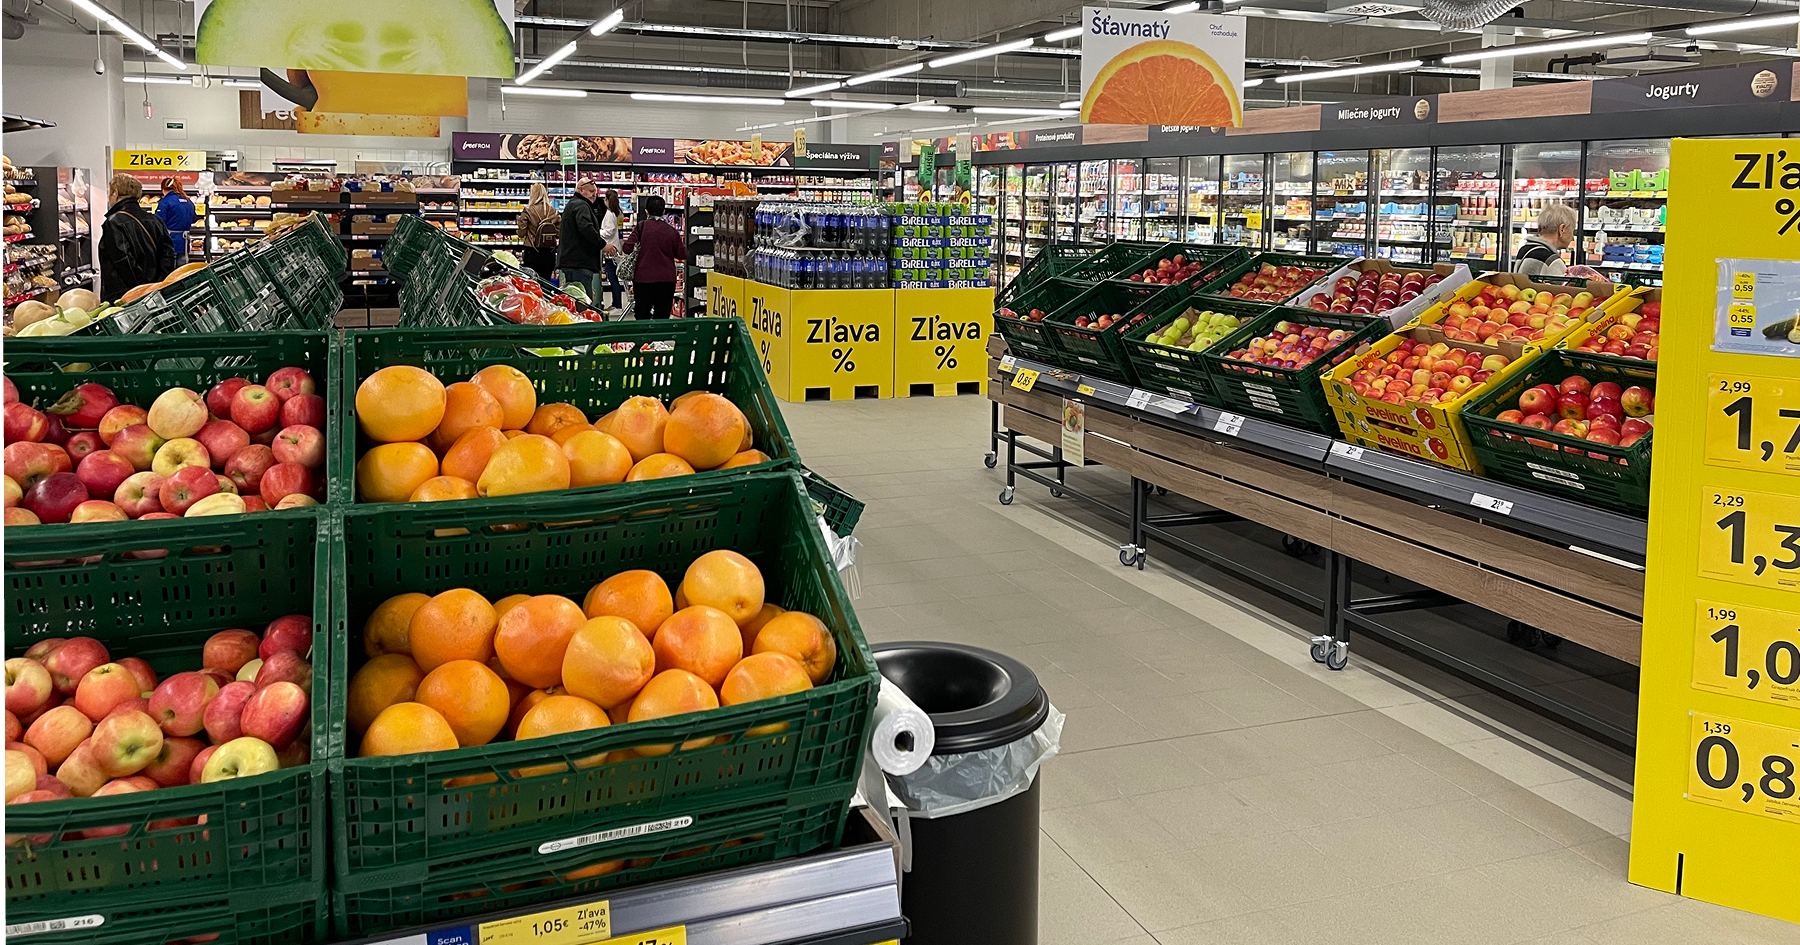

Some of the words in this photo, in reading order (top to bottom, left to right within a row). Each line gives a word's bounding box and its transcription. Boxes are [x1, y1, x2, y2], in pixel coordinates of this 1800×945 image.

[1091, 10, 1170, 39] Šťavnatý
[1645, 82, 1699, 100] Jogurty
[1338, 108, 1369, 120] Mliečne
[1369, 106, 1401, 120] jogurty
[1056, 132, 1075, 142] produkty
[130, 153, 172, 166] Zľava
[177, 155, 191, 166] %
[806, 149, 839, 160] Špeciálna
[839, 152, 861, 161] výživa
[1334, 178, 1355, 190] MIX
[712, 286, 737, 318] Zľava
[752, 297, 782, 338] Zľava
[806, 316, 880, 344] Zľava
[911, 314, 981, 341] Zľava
[761, 340, 772, 374] %
[831, 347, 856, 373] %
[934, 345, 958, 370] %
[1356, 350, 1381, 368] evelina
[1016, 372, 1033, 387] 0,85
[1719, 380, 1751, 394] 2,99
[1366, 405, 1410, 426] evelina
[1377, 433, 1421, 455] evelina
[1713, 494, 1744, 507] 2,29
[1707, 607, 1737, 621] 1,99
[1703, 721, 1731, 735] 1,39
[577, 907, 606, 921] Zľava
[74, 917, 94, 926] 216
[578, 918, 607, 932] -47%
[437, 935, 463, 945] Scan
